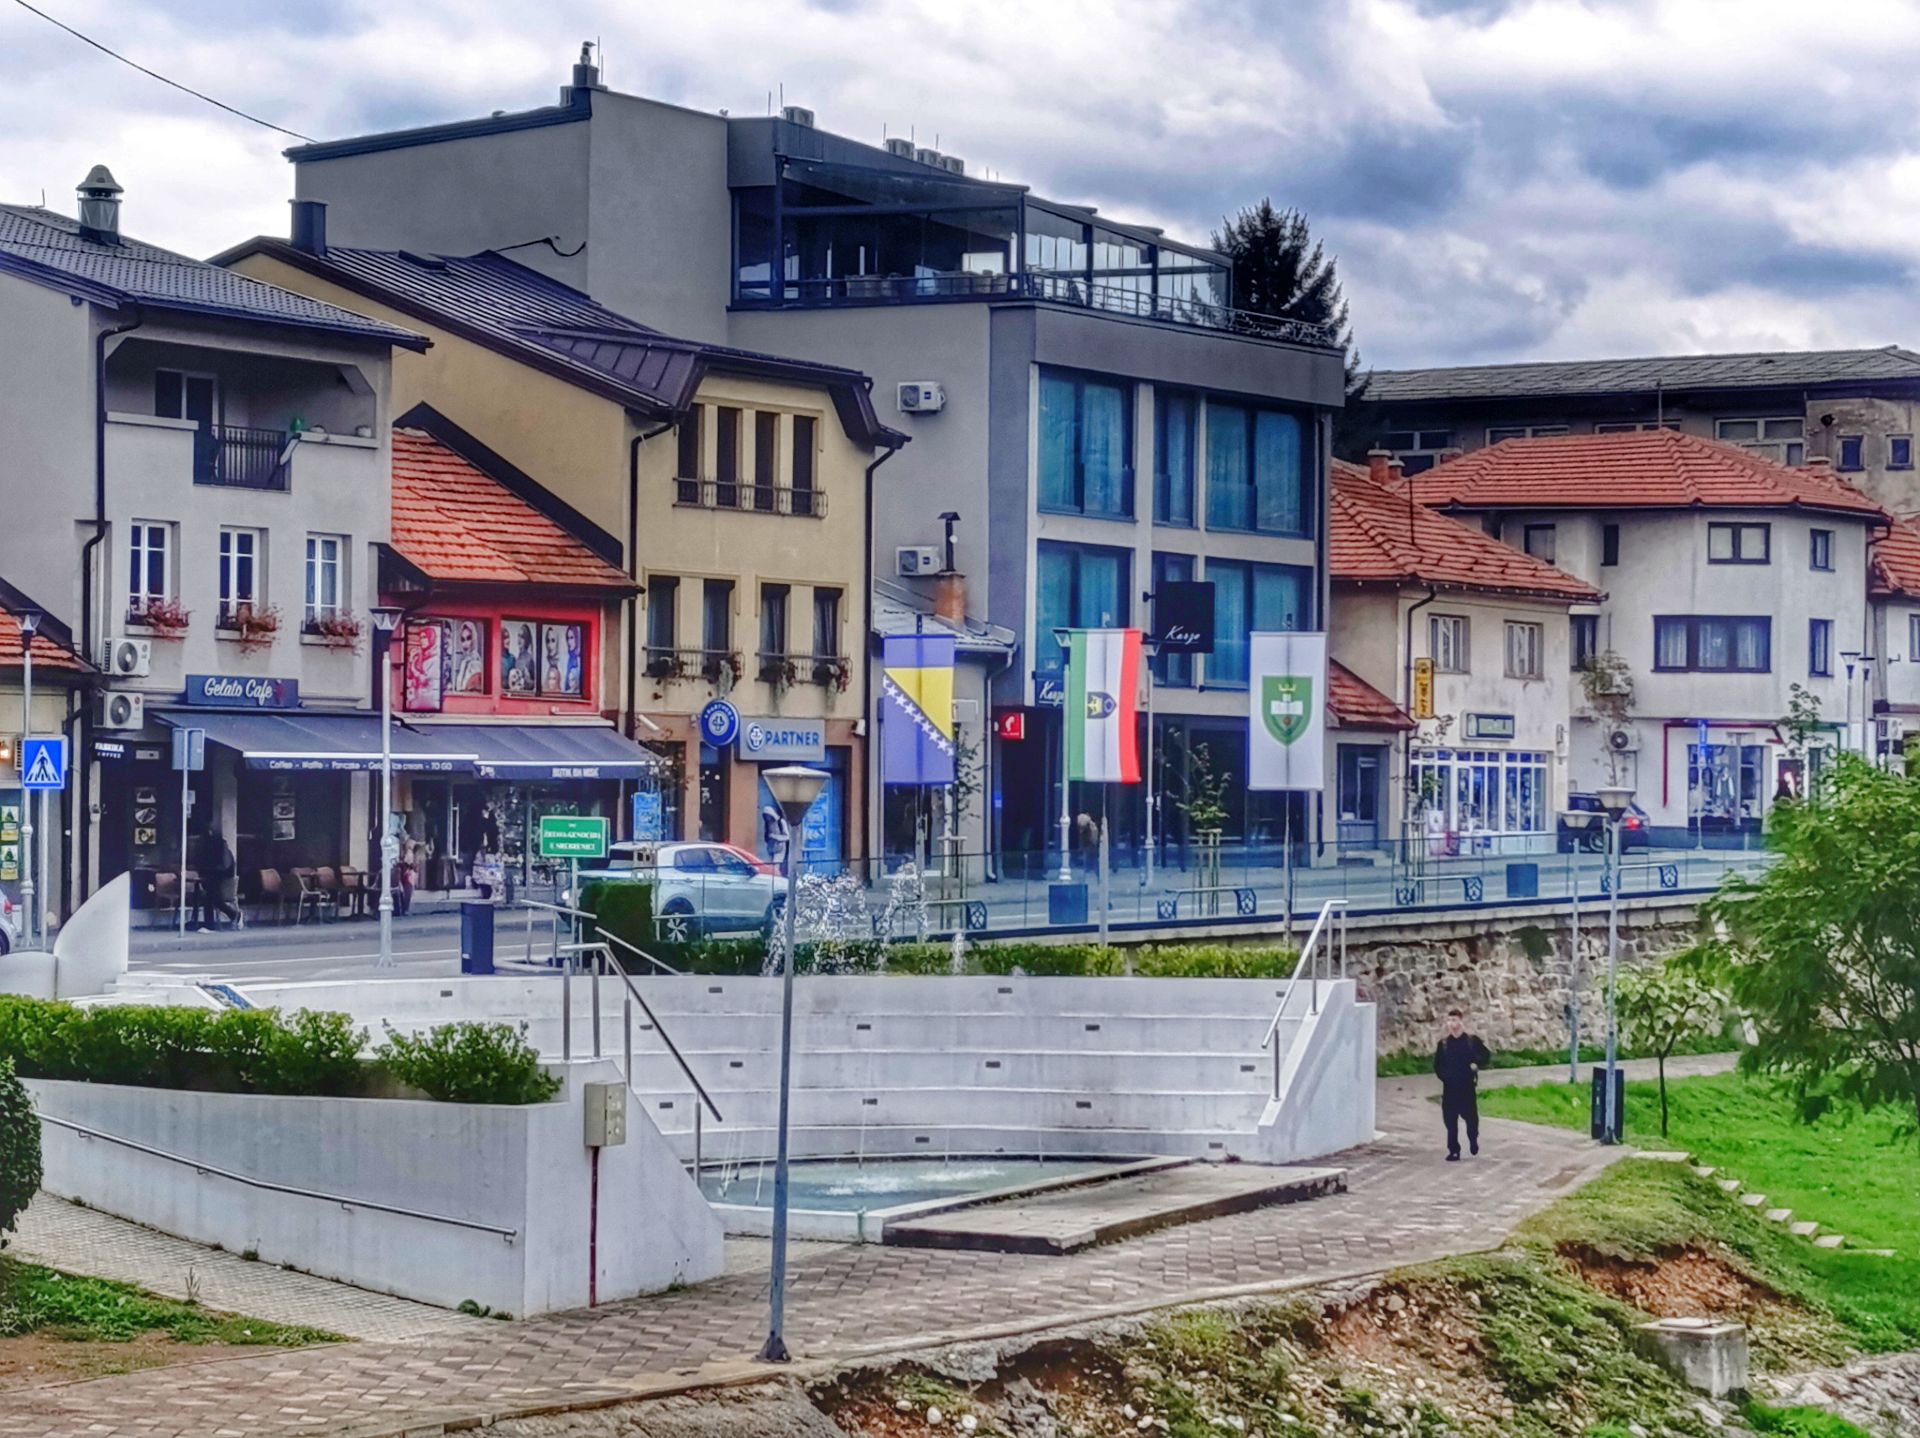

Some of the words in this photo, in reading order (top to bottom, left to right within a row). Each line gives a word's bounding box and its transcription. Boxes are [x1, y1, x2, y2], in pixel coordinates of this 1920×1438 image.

[204, 678, 242, 697] Gelato
[245, 679, 273, 706] Cafe
[764, 730, 820, 746] PARTNER
